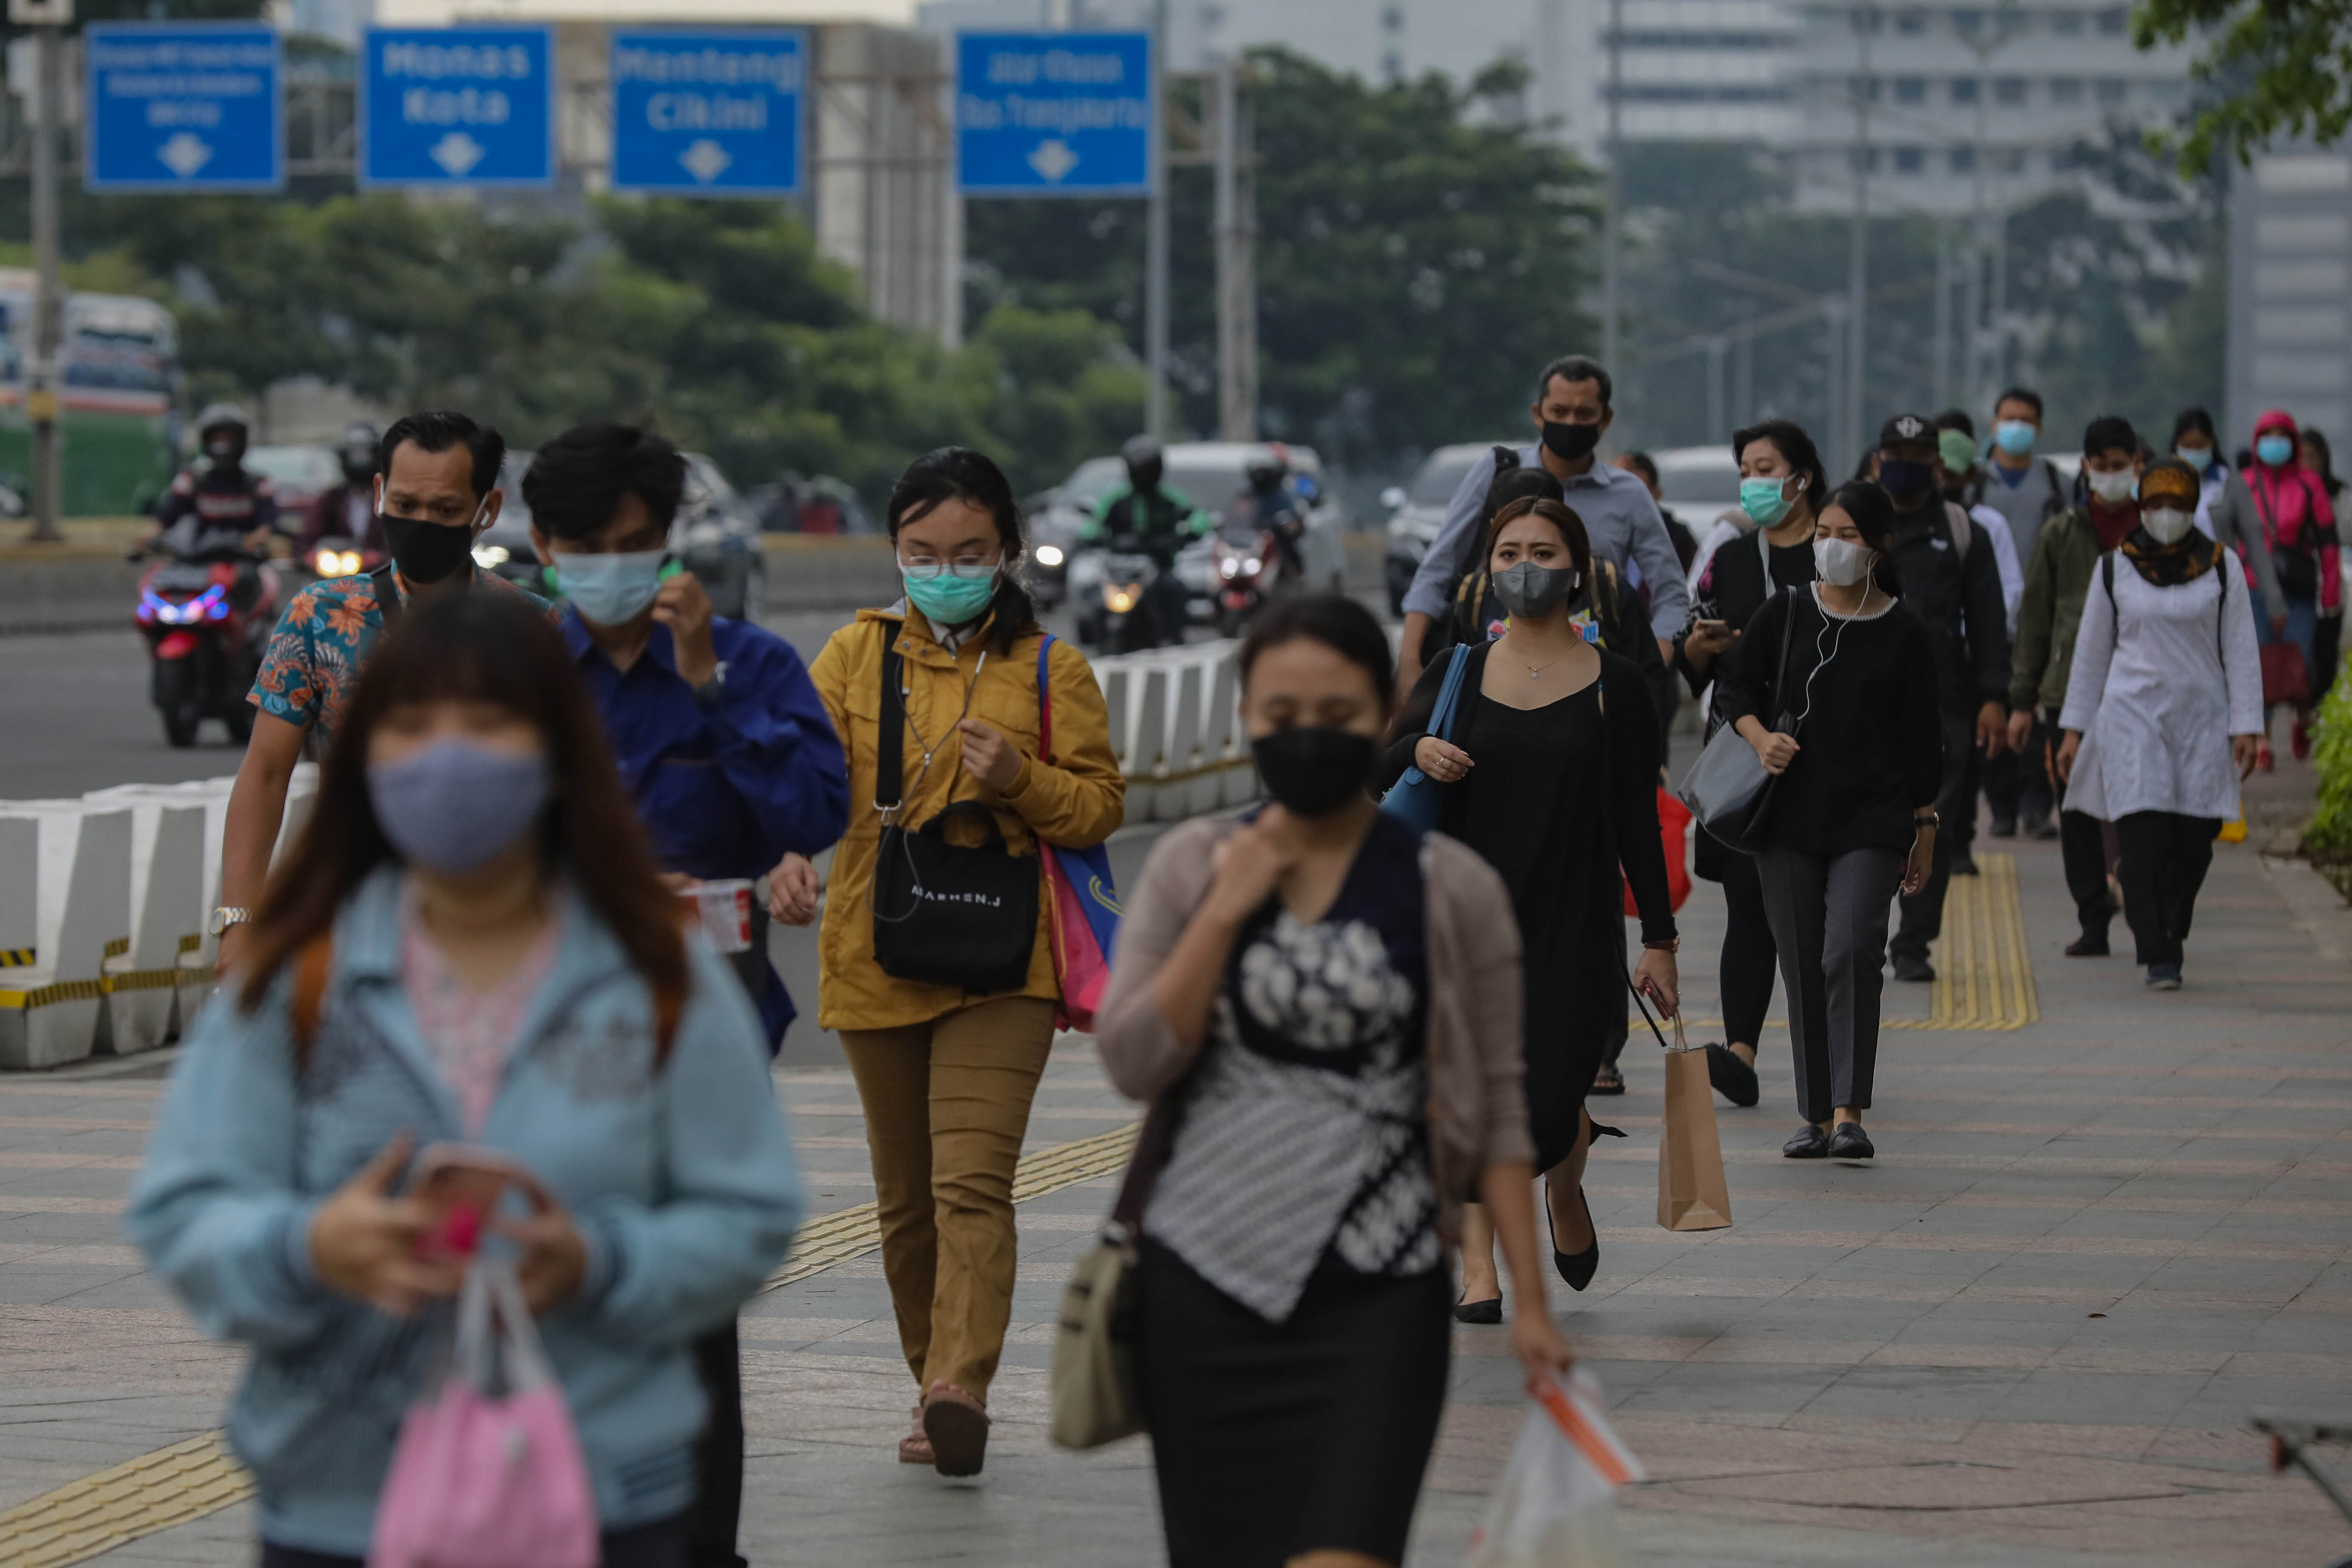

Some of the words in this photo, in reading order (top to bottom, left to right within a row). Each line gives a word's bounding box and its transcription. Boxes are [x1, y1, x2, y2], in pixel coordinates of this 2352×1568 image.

[384, 42, 530, 79] Monas
[404, 87, 510, 124] Kota
[647, 92, 767, 130] Cikini
